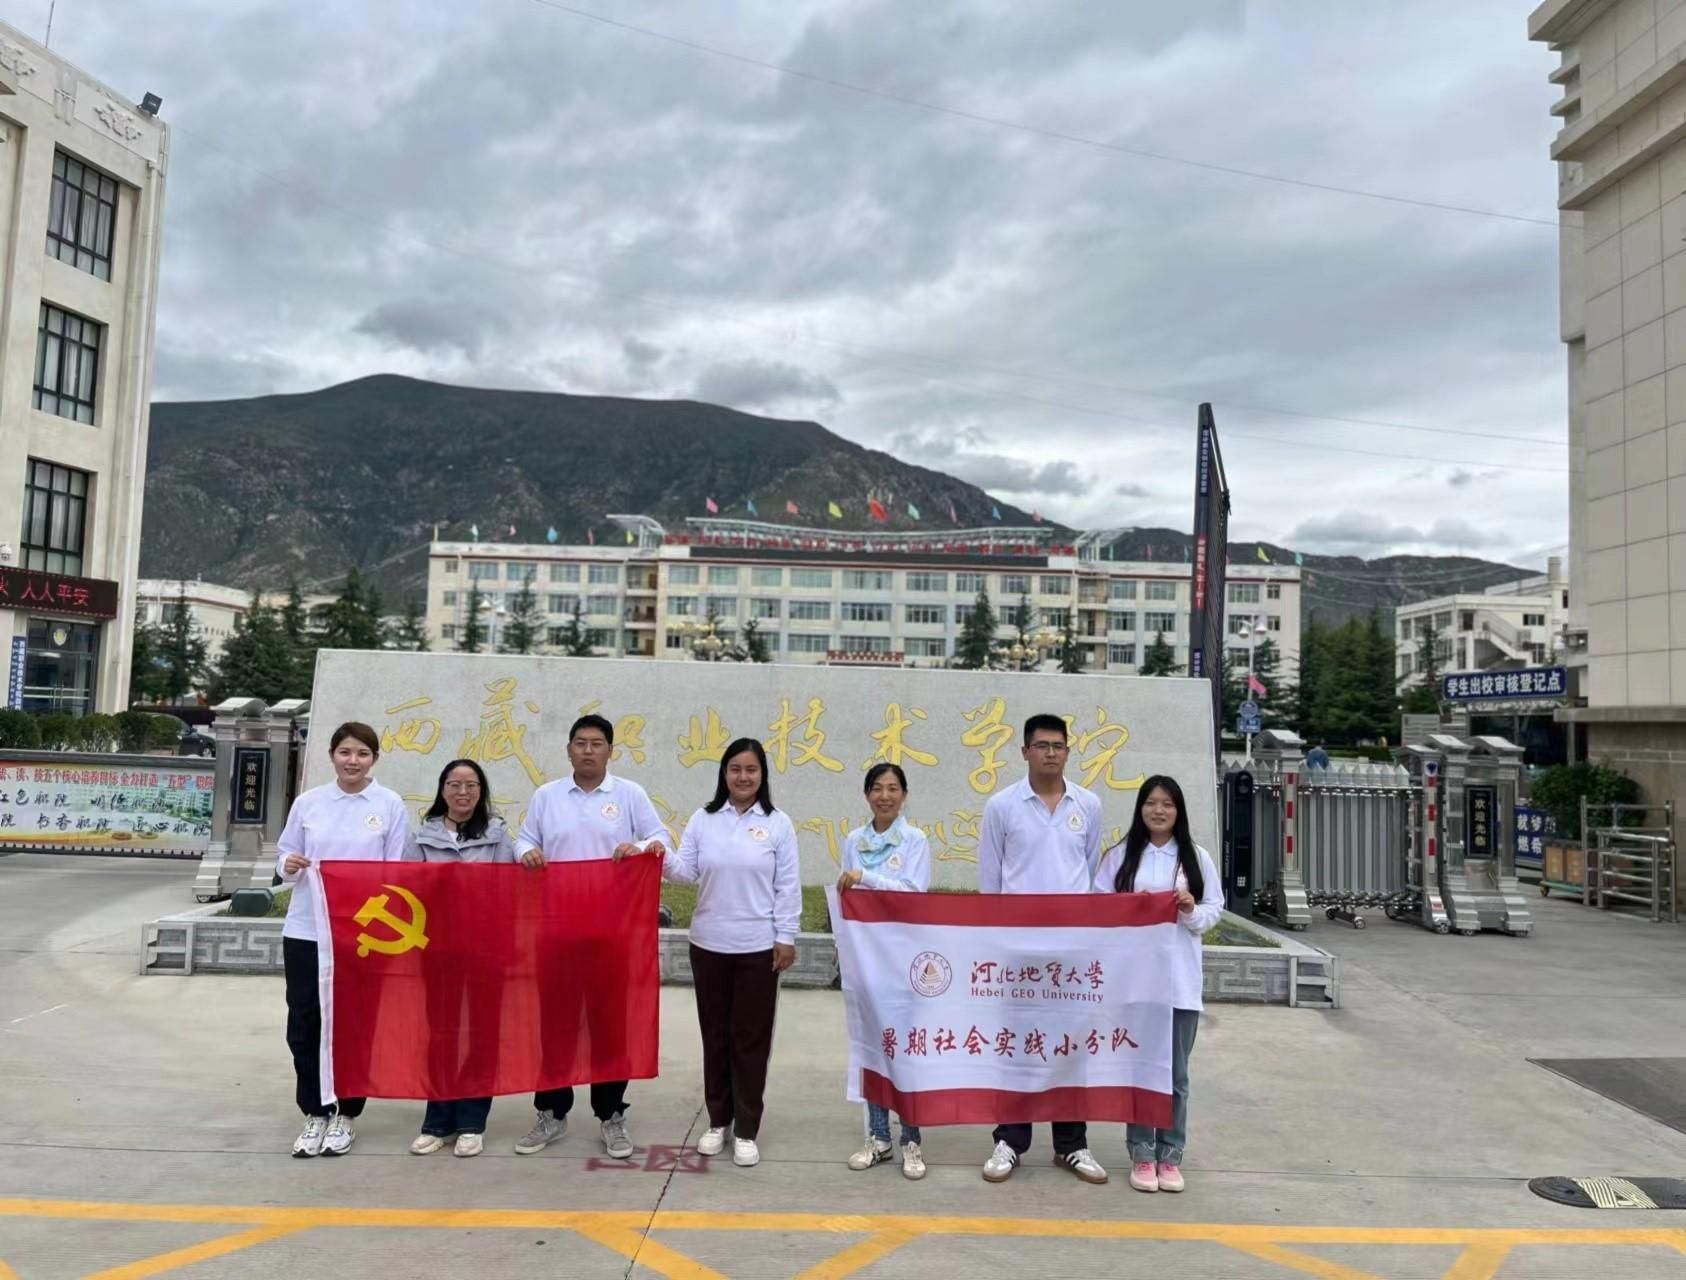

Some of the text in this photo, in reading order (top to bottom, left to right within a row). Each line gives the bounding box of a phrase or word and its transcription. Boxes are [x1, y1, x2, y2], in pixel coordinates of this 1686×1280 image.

[1447, 671, 1561, 697] 学生出校审核登记点
[381, 676, 1145, 793] 西藏职业技术学院
[244, 762, 257, 811] 欢迎光临
[971, 960, 1104, 989] 河北地质大学
[971, 987, 1104, 1003] Hebei GEO University
[881, 1025, 1139, 1062] 暑期社会实践小分队
